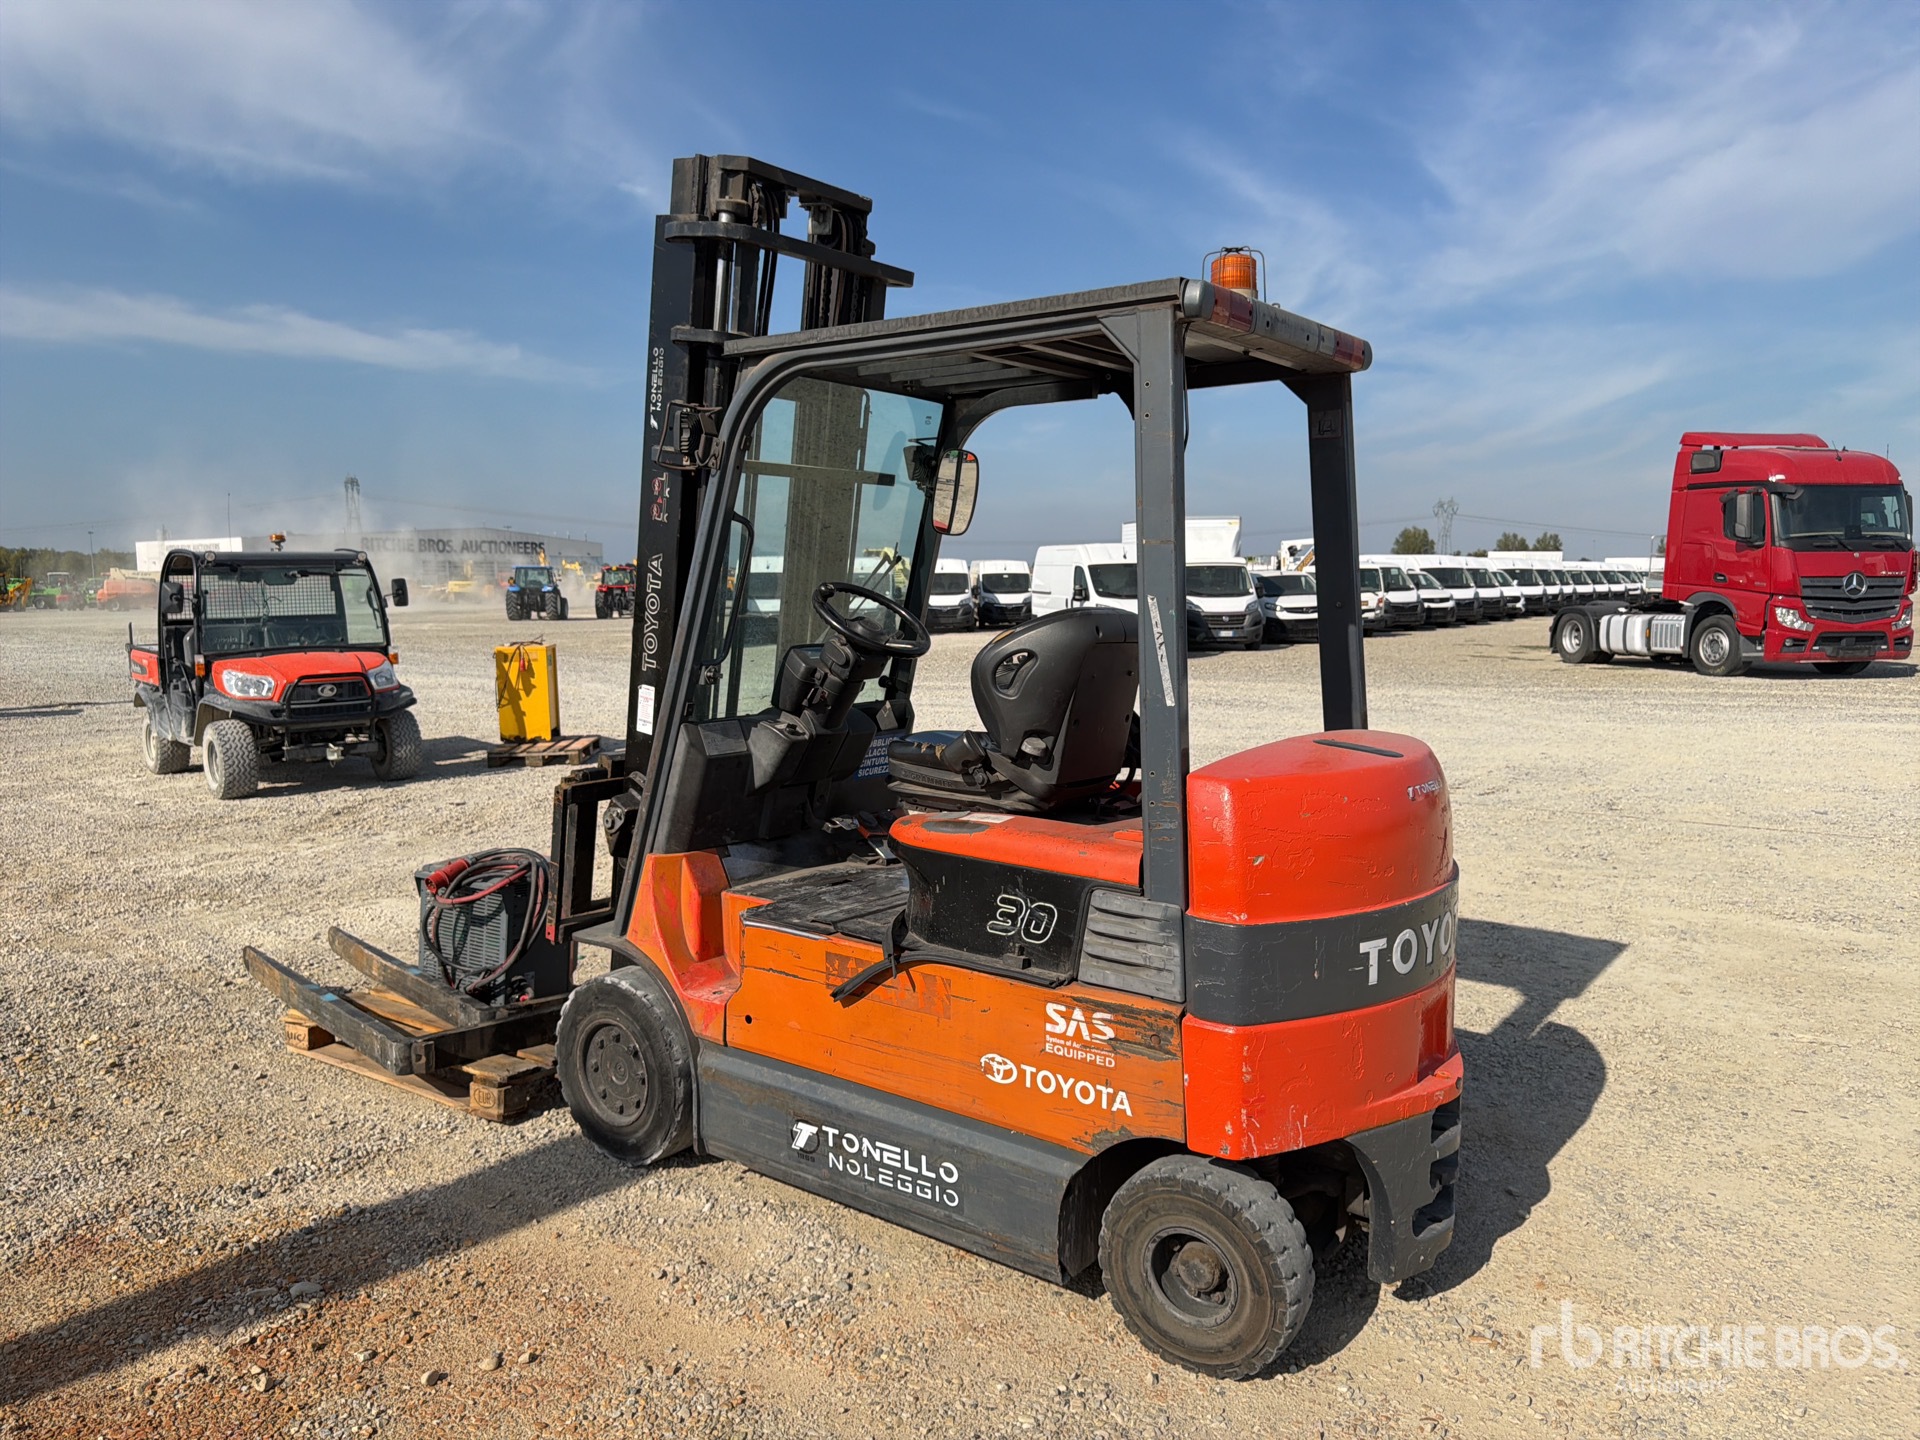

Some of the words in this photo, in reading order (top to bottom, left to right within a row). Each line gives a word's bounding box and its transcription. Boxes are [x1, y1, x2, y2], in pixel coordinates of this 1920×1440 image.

[650, 347, 659, 412] TONELLO
[656, 347, 665, 411] NOLEGGIO
[361, 537, 415, 552] RITCHIE
[418, 538, 457, 554] BROS.
[461, 540, 545, 555] AUCTIONEERS
[642, 553, 664, 671] TOYOTA
[987, 894, 1058, 944] 30
[1045, 1002, 1116, 1043] SAS
[1045, 1042, 1116, 1068] EQUIPPED
[1021, 1063, 1133, 1117] TOYOTA
[821, 1125, 958, 1184] TONELLO
[828, 1152, 960, 1207] NOLEGGIO
